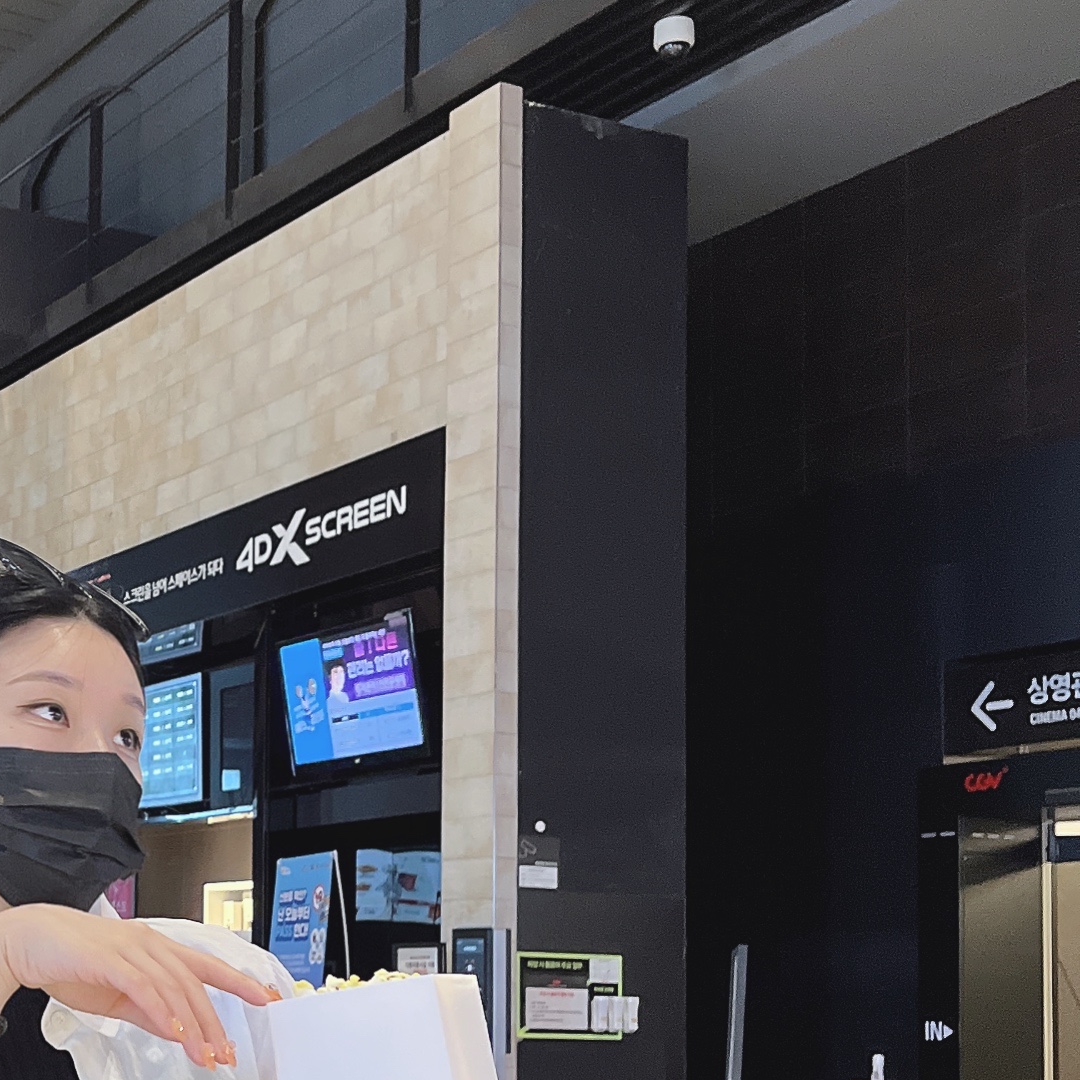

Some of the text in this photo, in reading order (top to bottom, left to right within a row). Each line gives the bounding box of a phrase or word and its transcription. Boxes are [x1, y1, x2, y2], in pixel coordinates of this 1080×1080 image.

[236, 485, 407, 572] 4DX SCREEN
[1029, 709, 1067, 726] CINEMA
[925, 1020, 943, 1041] IN
